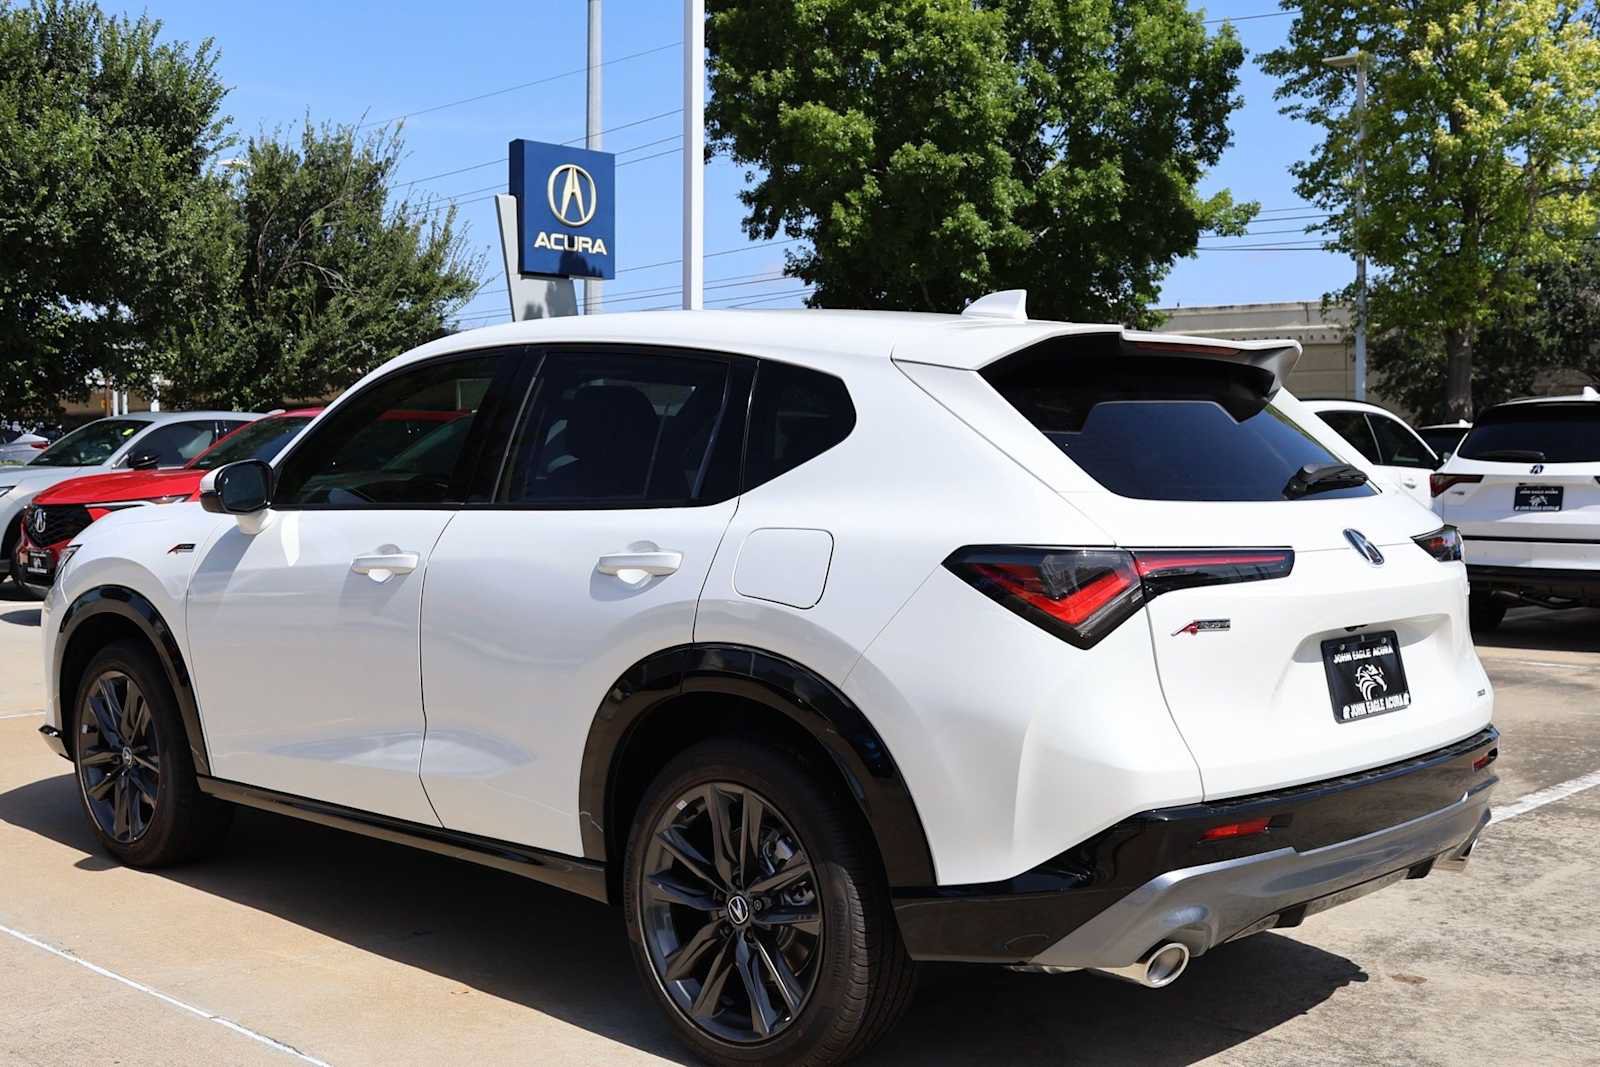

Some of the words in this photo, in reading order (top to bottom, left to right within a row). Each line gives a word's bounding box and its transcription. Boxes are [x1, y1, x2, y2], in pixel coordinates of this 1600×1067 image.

[534, 231, 607, 255] ACURA
[1334, 652, 1352, 664] JOHN
[1352, 649, 1371, 660] EAGLE
[1373, 645, 1393, 657] ACURA
[1350, 702, 1366, 718] JOHN
[1366, 698, 1386, 713] EAGLE
[1385, 694, 1404, 709] ACURA
